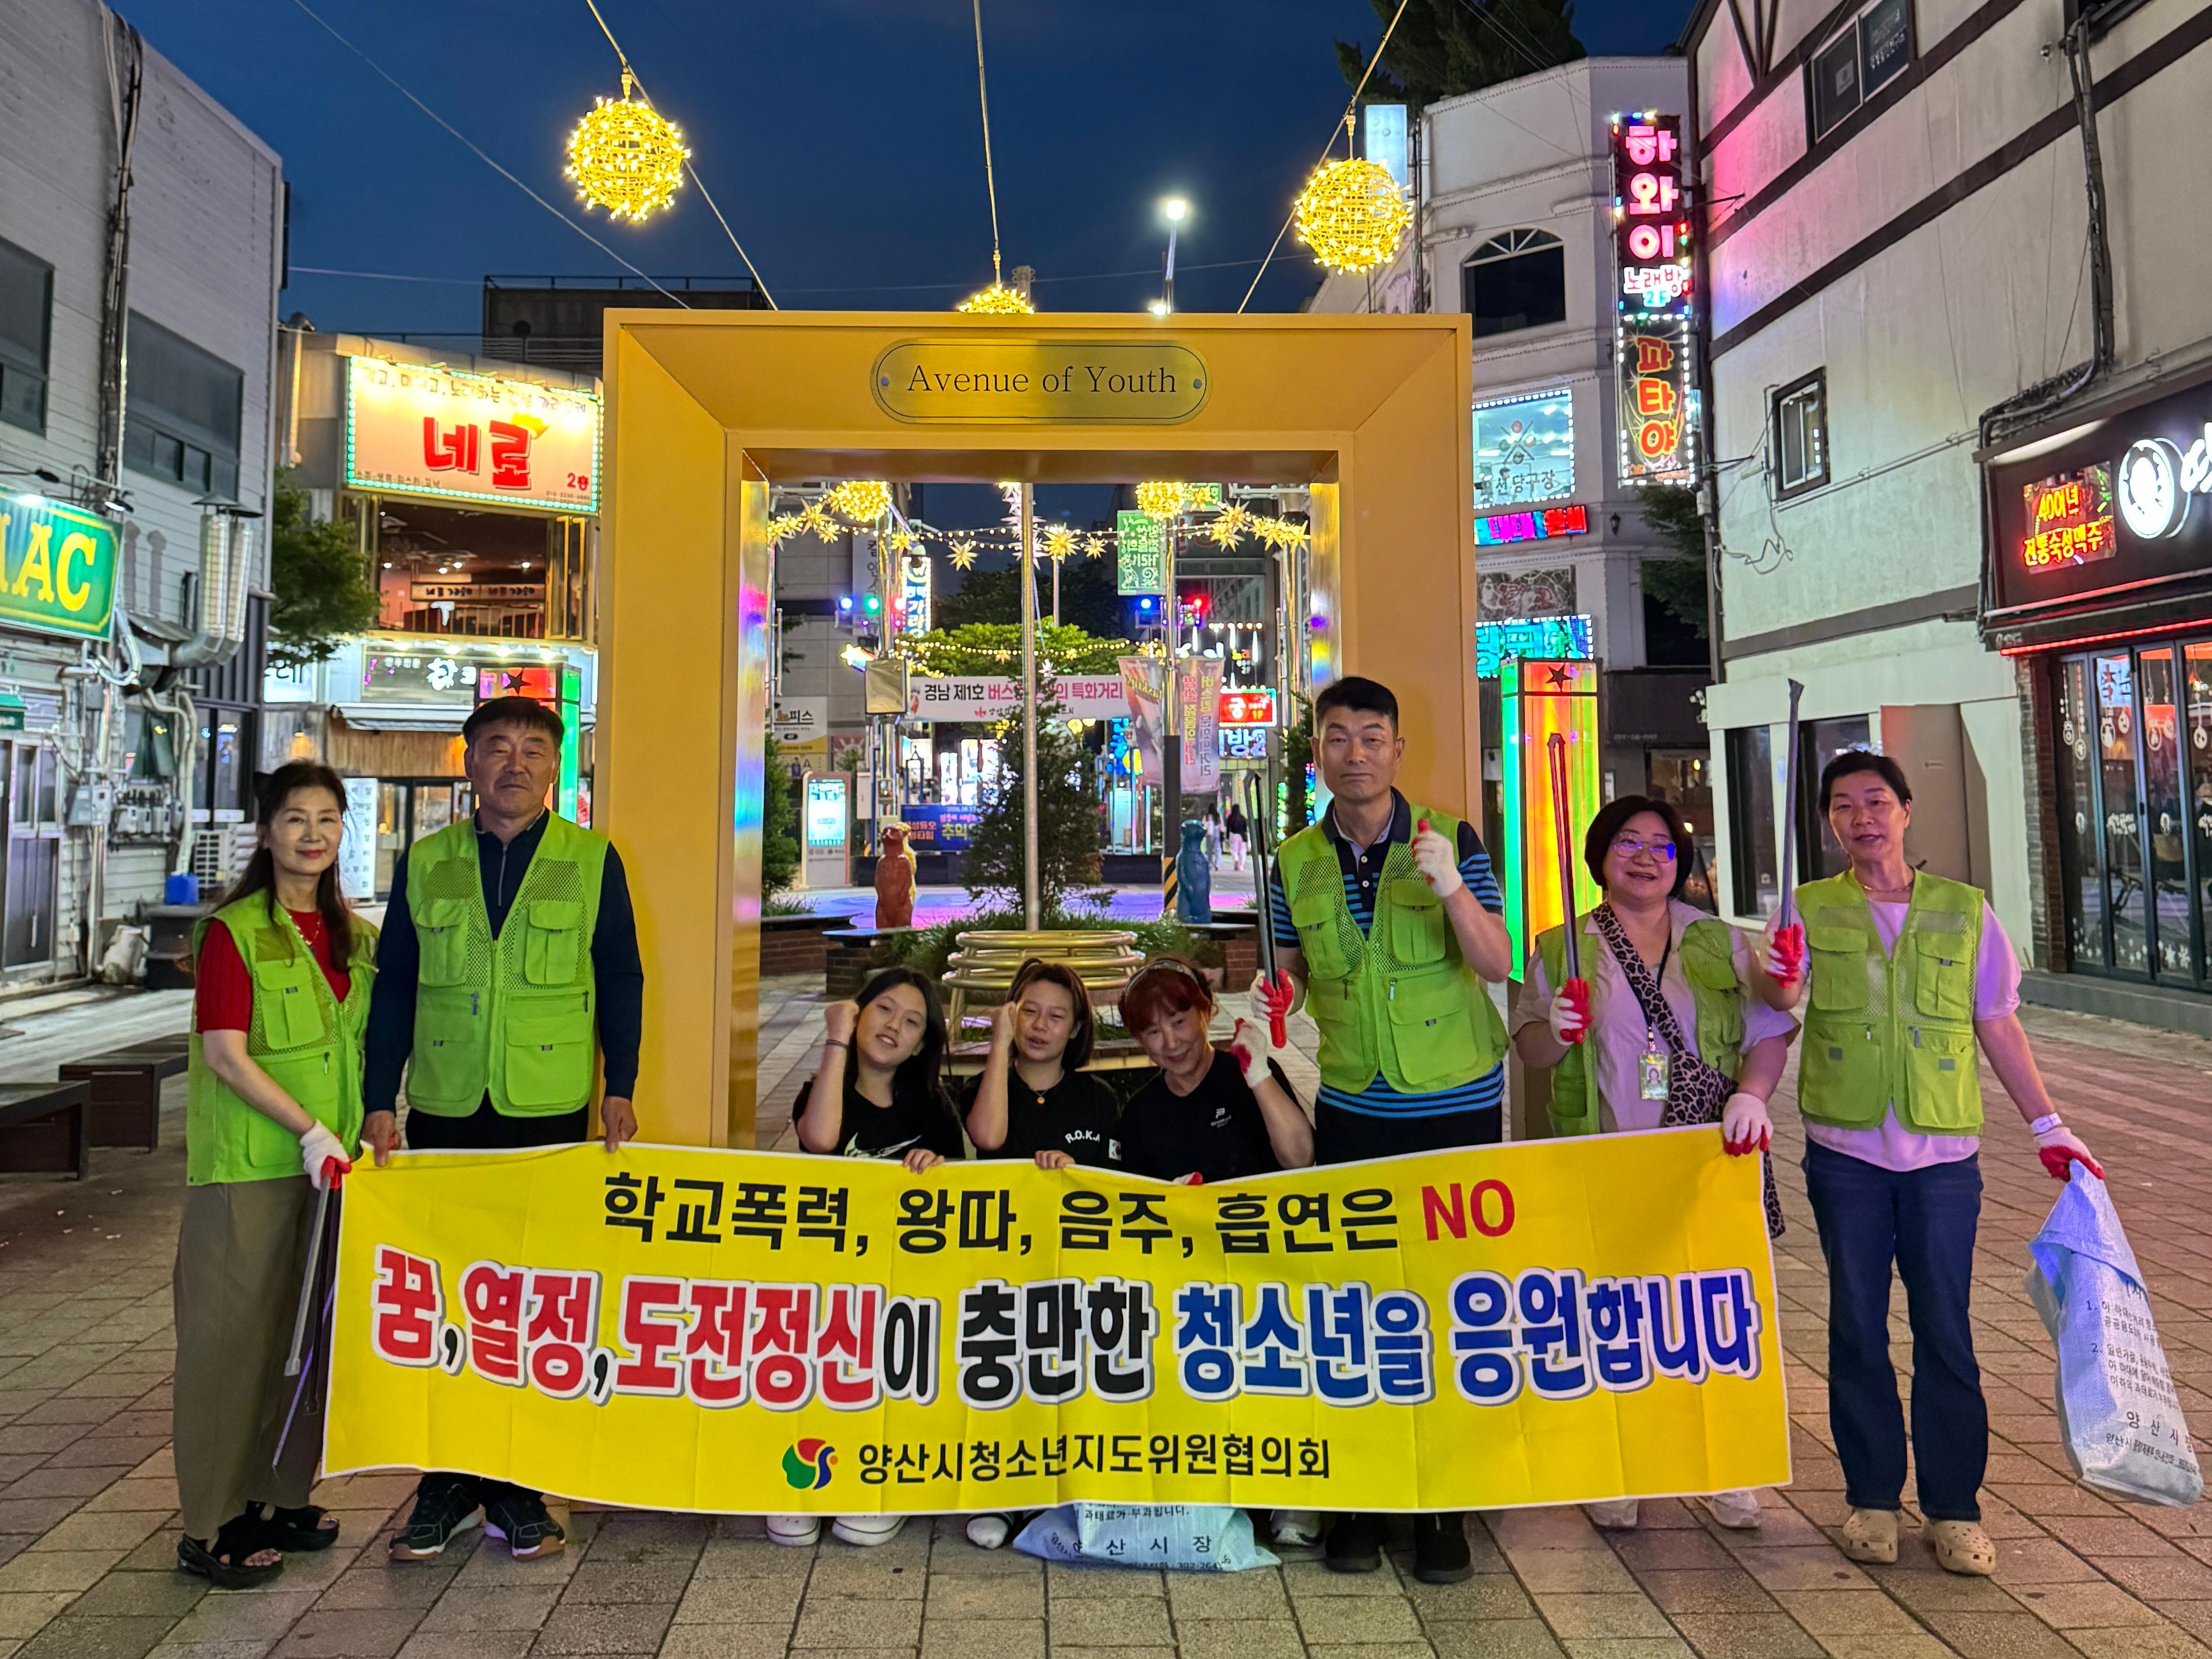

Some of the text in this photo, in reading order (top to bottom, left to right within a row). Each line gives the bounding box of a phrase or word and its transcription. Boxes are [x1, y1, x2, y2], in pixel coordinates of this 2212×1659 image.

[1625, 126, 1677, 260] 하와이
[1626, 268, 1681, 293] 노래방
[1646, 290, 1667, 304] 2F
[907, 365, 1177, 393] Avenue of Youth
[1635, 335, 1677, 458] 파타야
[423, 416, 531, 490] 네로
[566, 472, 589, 491] 2층
[0, 513, 97, 612] AC
[2024, 521, 2103, 566] 전통숙성맥주
[925, 684, 950, 701] 경남
[954, 684, 985, 701] 제1호
[1072, 682, 1123, 700] 특화거리
[605, 1171, 1515, 1258] 학교폭력, 왕따, 음주, 흡연은 NO
[961, 1281, 1150, 1402] 충만한
[1179, 1288, 1421, 1396] 청소년을
[1453, 1274, 1751, 1396] 응원합니다
[859, 1434, 1330, 1484] 양산시청소년지도위원협의회
[1085, 1505, 1189, 1522] 과태료가 부과됩니다.
